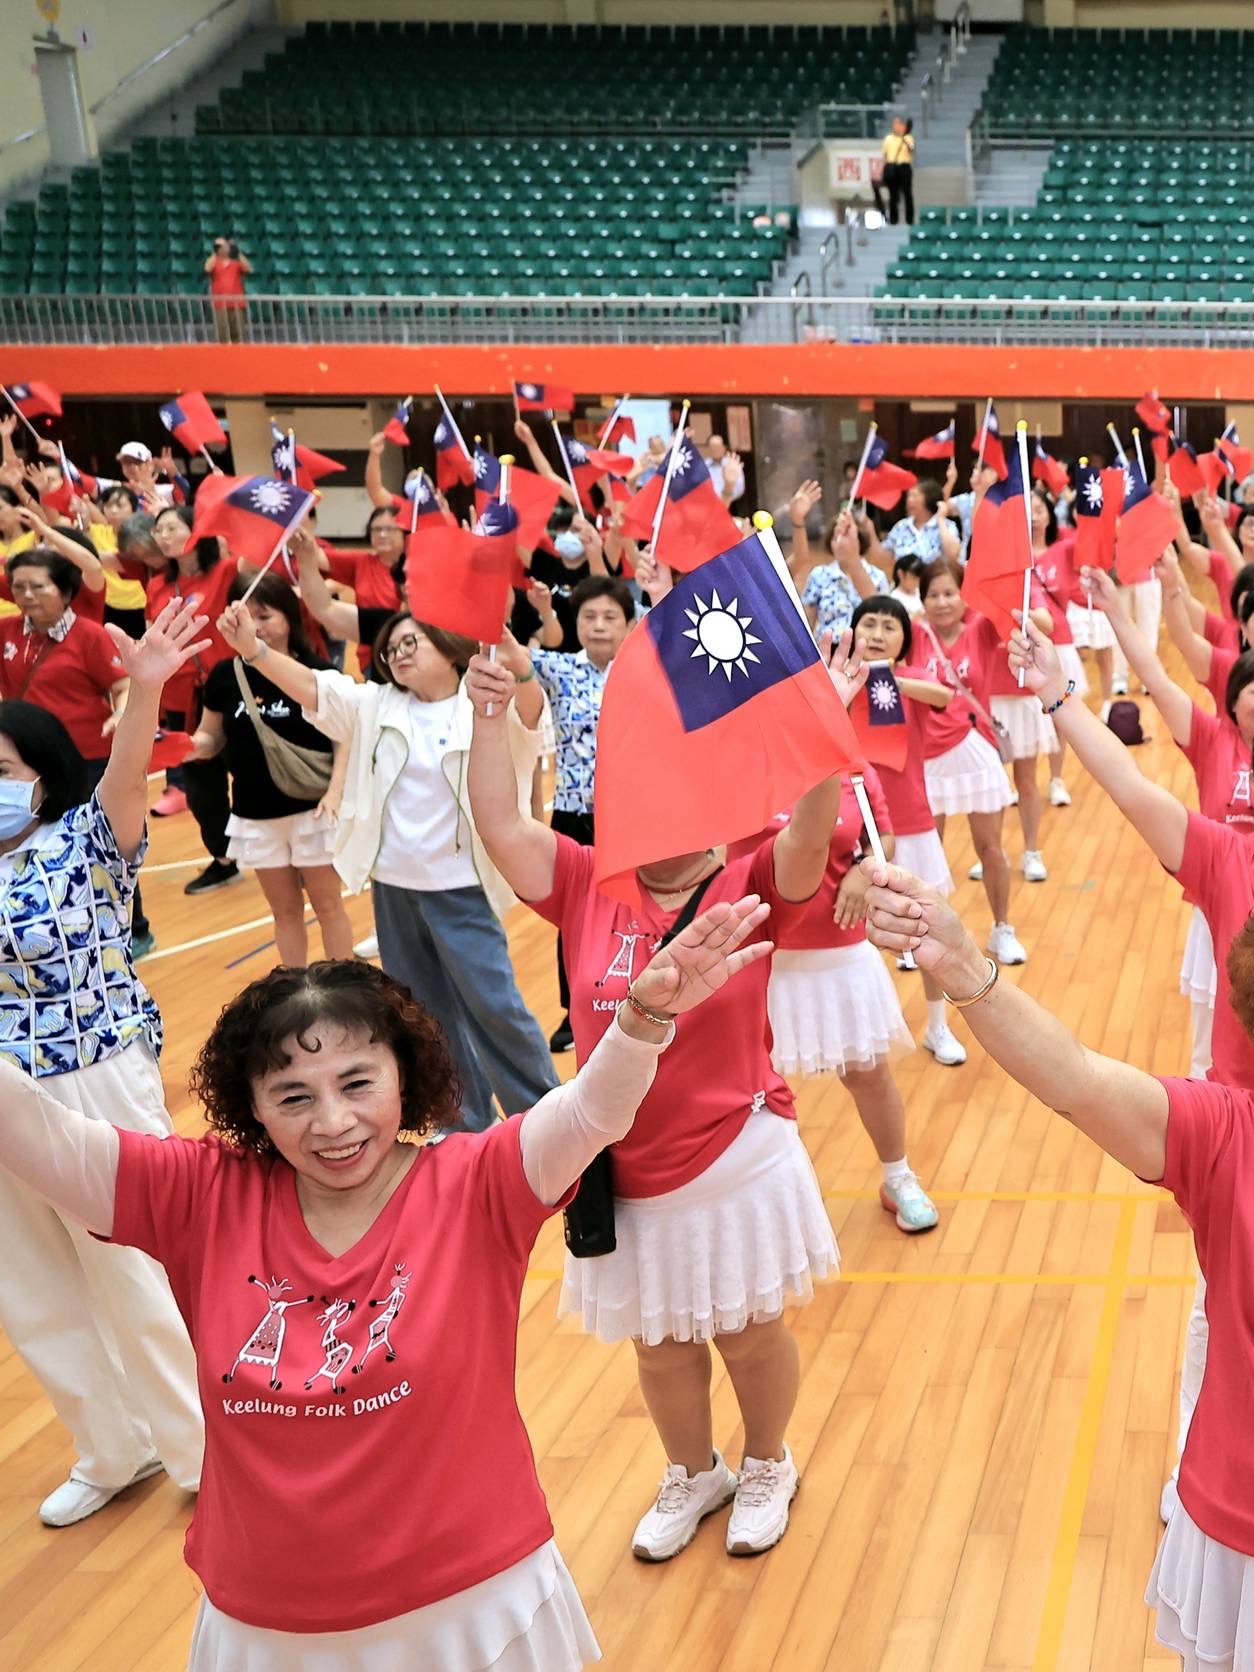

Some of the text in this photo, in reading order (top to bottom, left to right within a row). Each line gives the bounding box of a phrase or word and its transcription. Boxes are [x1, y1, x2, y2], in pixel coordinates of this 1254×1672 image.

[222, 1380, 412, 1417] Keelung Folk Dance
